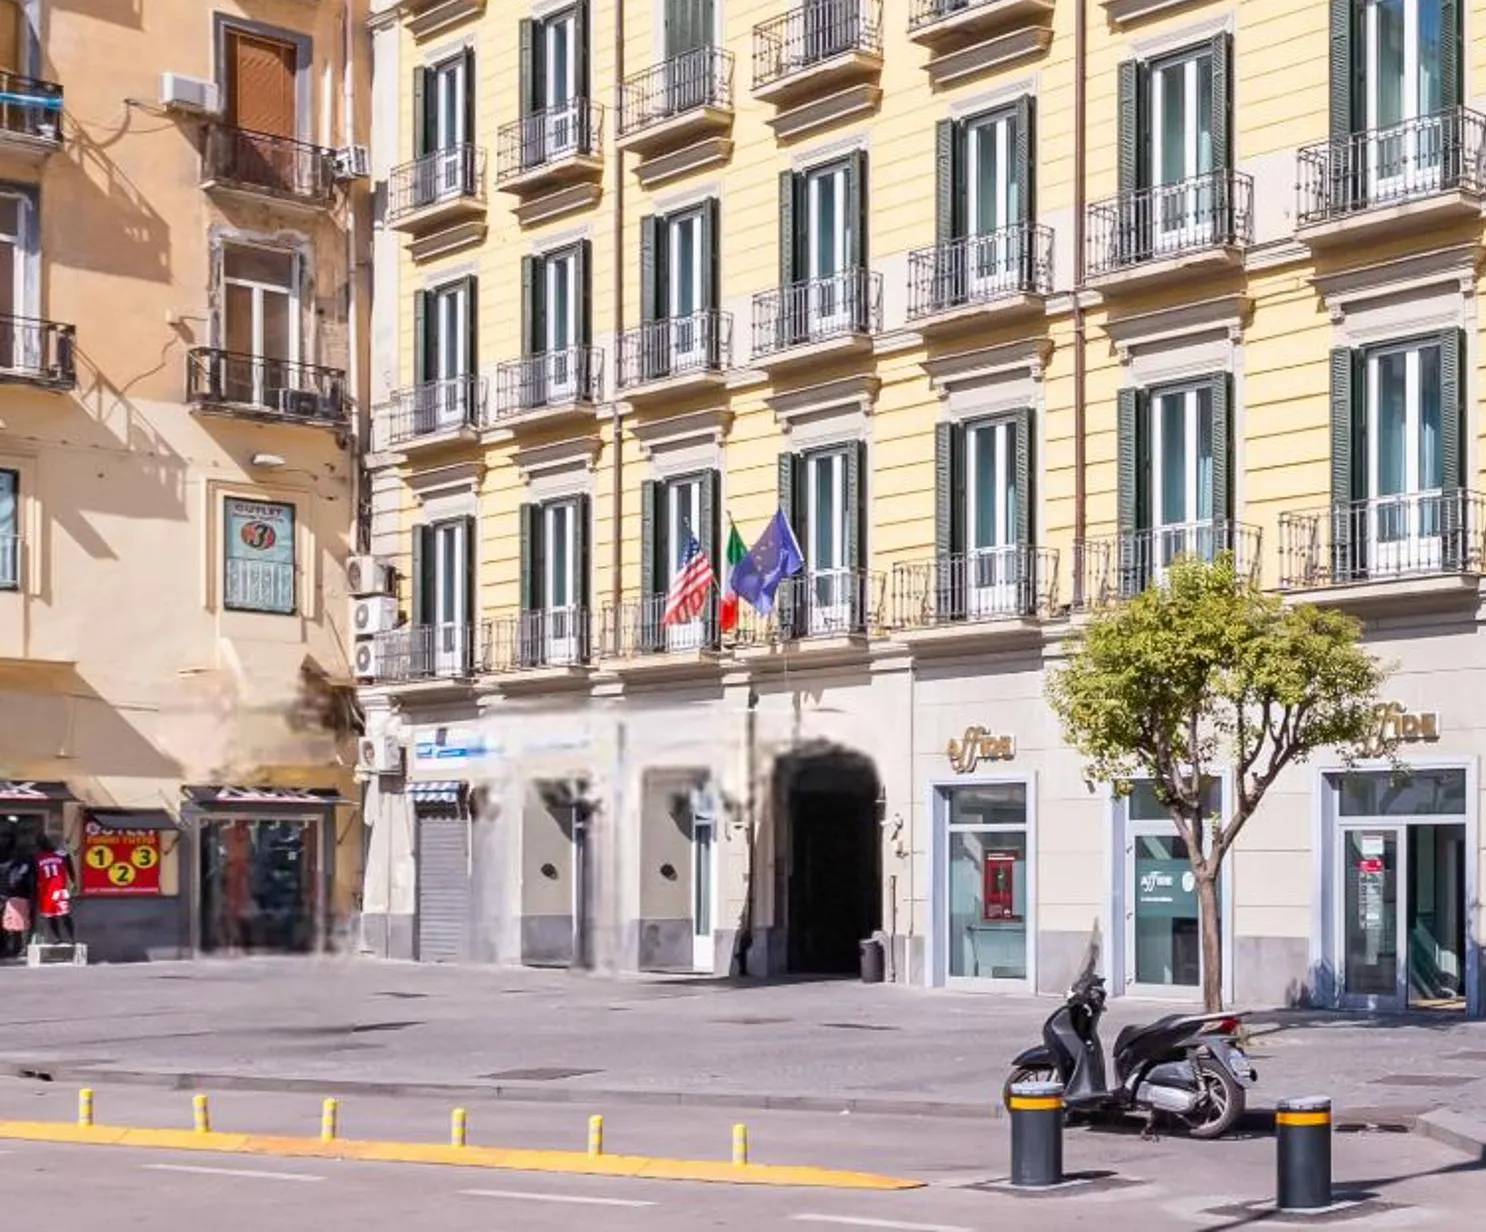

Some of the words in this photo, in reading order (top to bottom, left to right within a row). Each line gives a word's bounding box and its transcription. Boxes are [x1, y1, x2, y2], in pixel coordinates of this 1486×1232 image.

[95, 849, 105, 866] 1
[138, 849, 151, 866] 3
[44, 864, 58, 878] 11
[117, 866, 129, 882] 2
